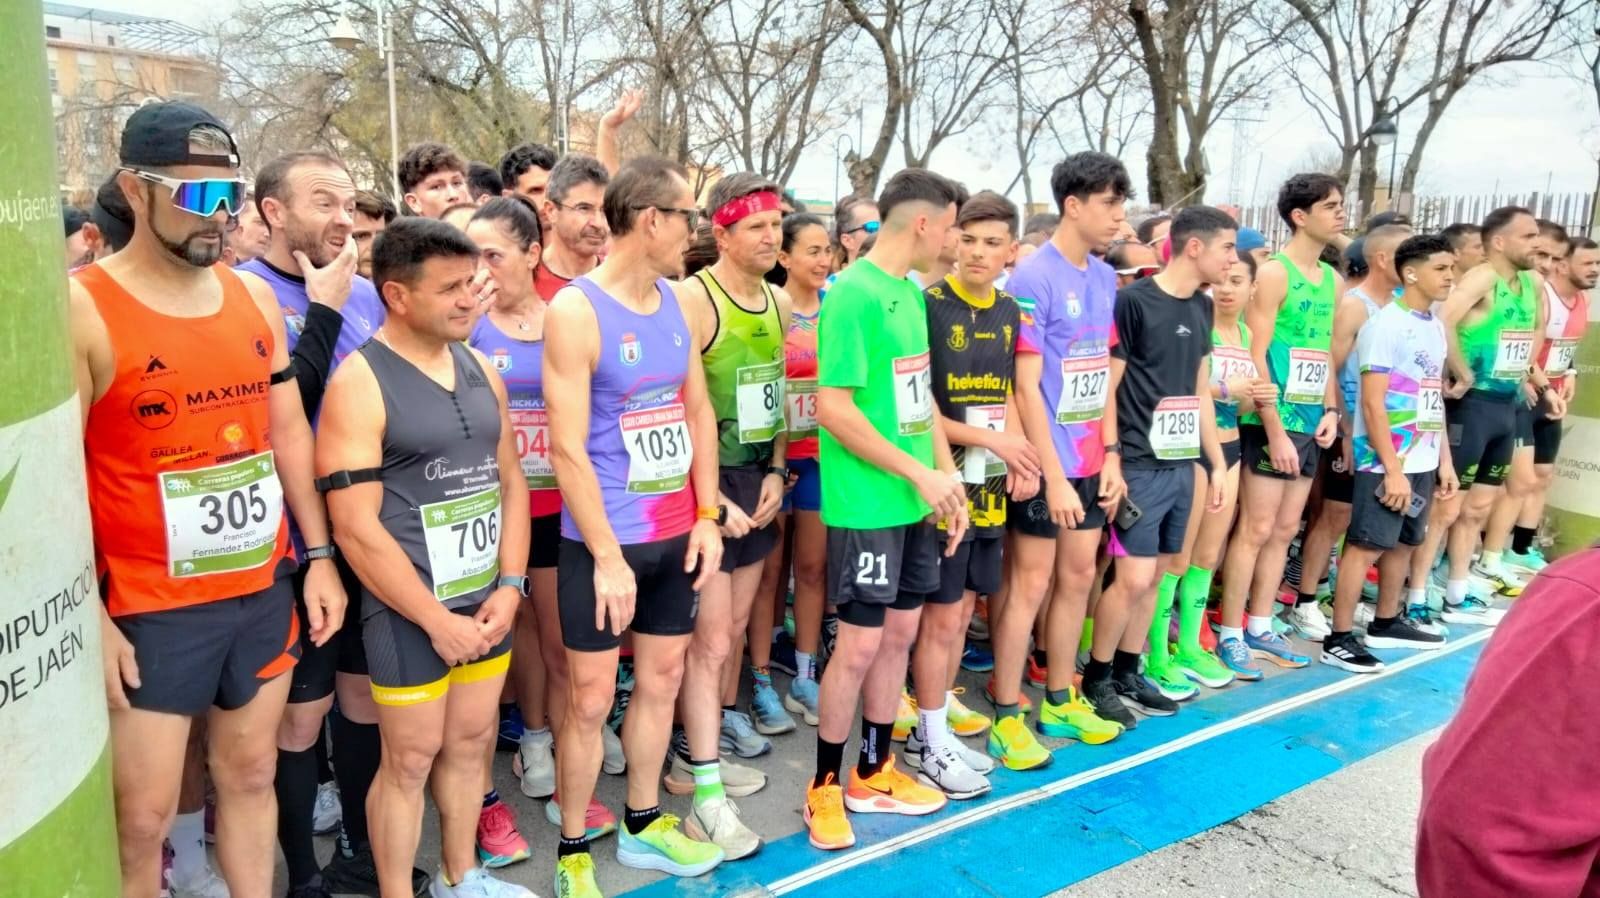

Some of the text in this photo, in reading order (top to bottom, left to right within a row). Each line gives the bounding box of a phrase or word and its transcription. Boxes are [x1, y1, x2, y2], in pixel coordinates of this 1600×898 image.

[1071, 370, 1106, 398] 1327
[1157, 412, 1195, 436] 1289
[634, 425, 686, 462] 1031
[199, 483, 267, 535] 305
[192, 544, 242, 558] Fernandez
[223, 530, 257, 542] Francisco
[451, 511, 497, 558] 706
[856, 551, 889, 585] 21
[0, 560, 94, 655] IPUTACIÓ
[33, 624, 83, 690] JAÉN
